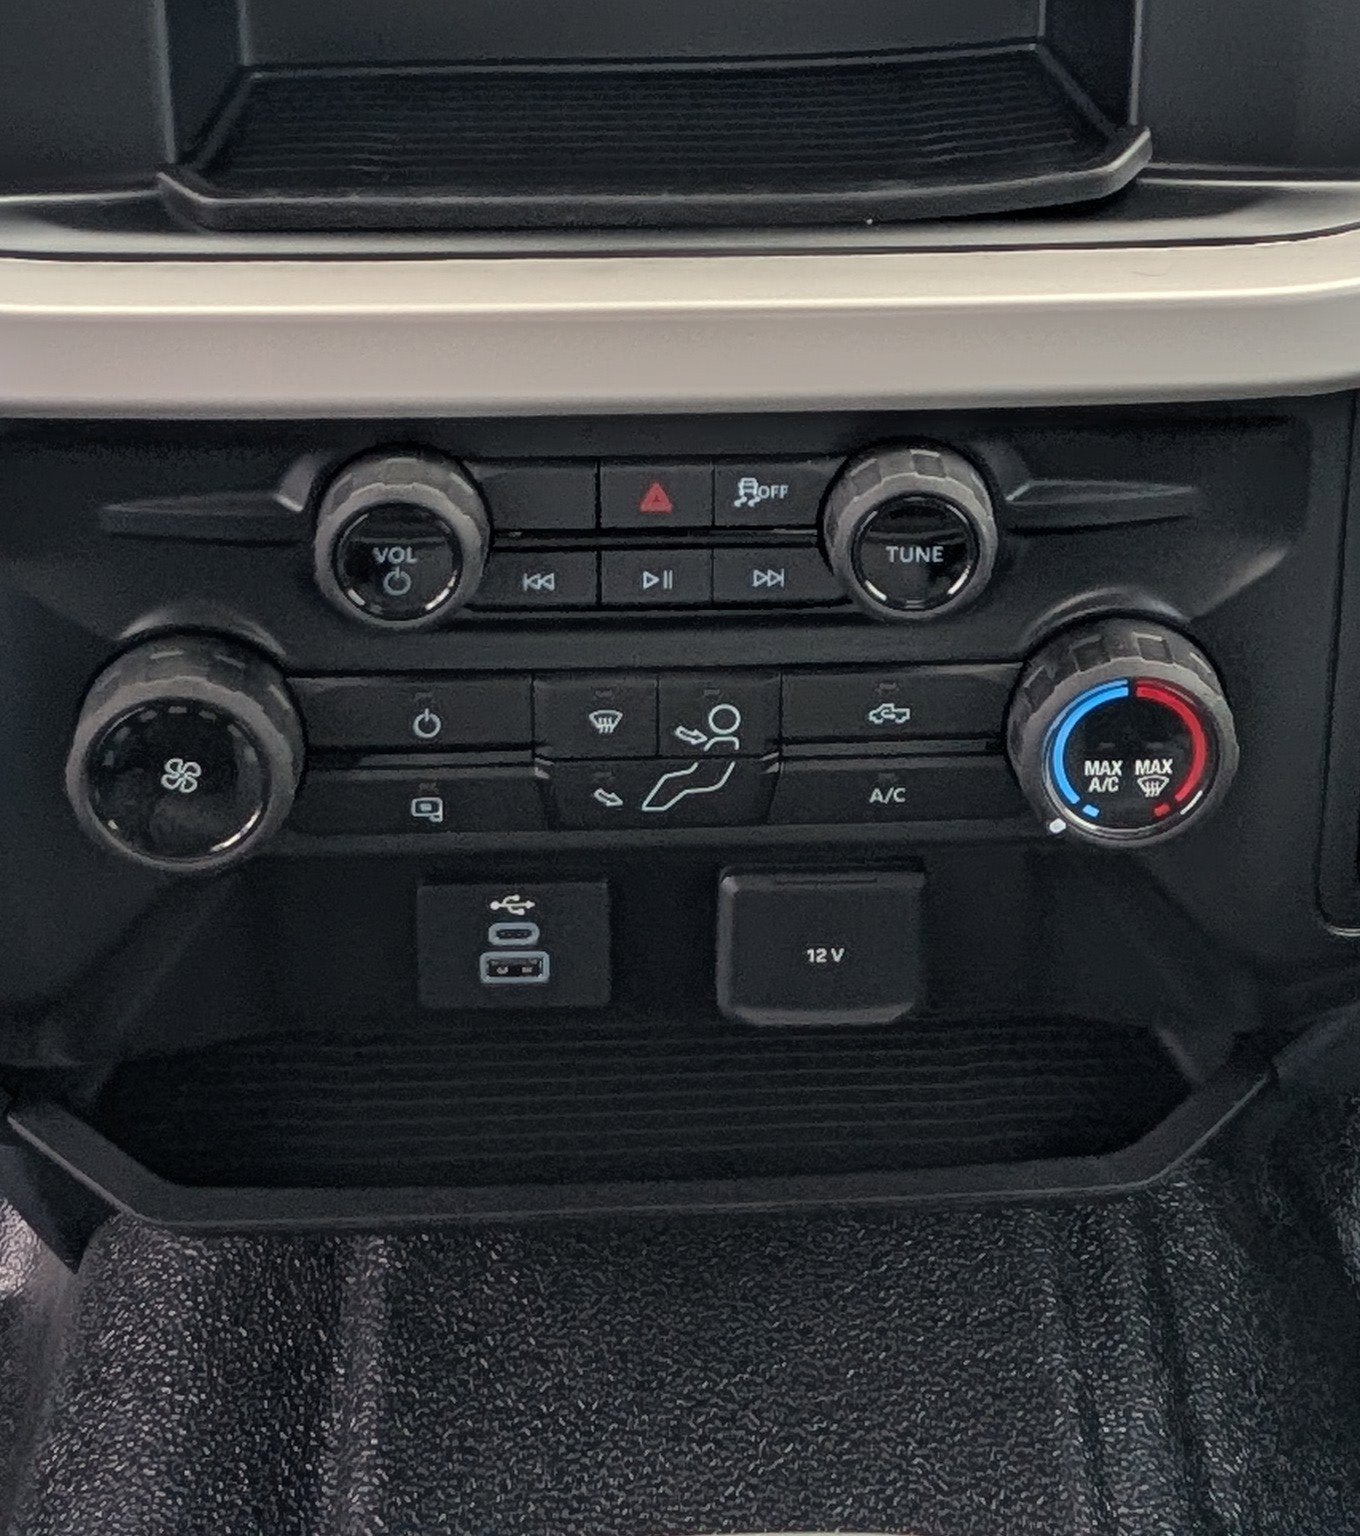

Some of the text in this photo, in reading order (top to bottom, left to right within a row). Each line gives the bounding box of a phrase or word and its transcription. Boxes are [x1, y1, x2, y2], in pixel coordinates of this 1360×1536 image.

[758, 484, 789, 500] OFF
[373, 545, 418, 565] VOL
[885, 545, 944, 565] TUNE
[1084, 759, 1123, 776] MAX
[1135, 758, 1174, 775] MAX
[1087, 776, 1120, 793] A/C
[869, 786, 907, 805] A/C
[806, 947, 846, 964] 12 V
